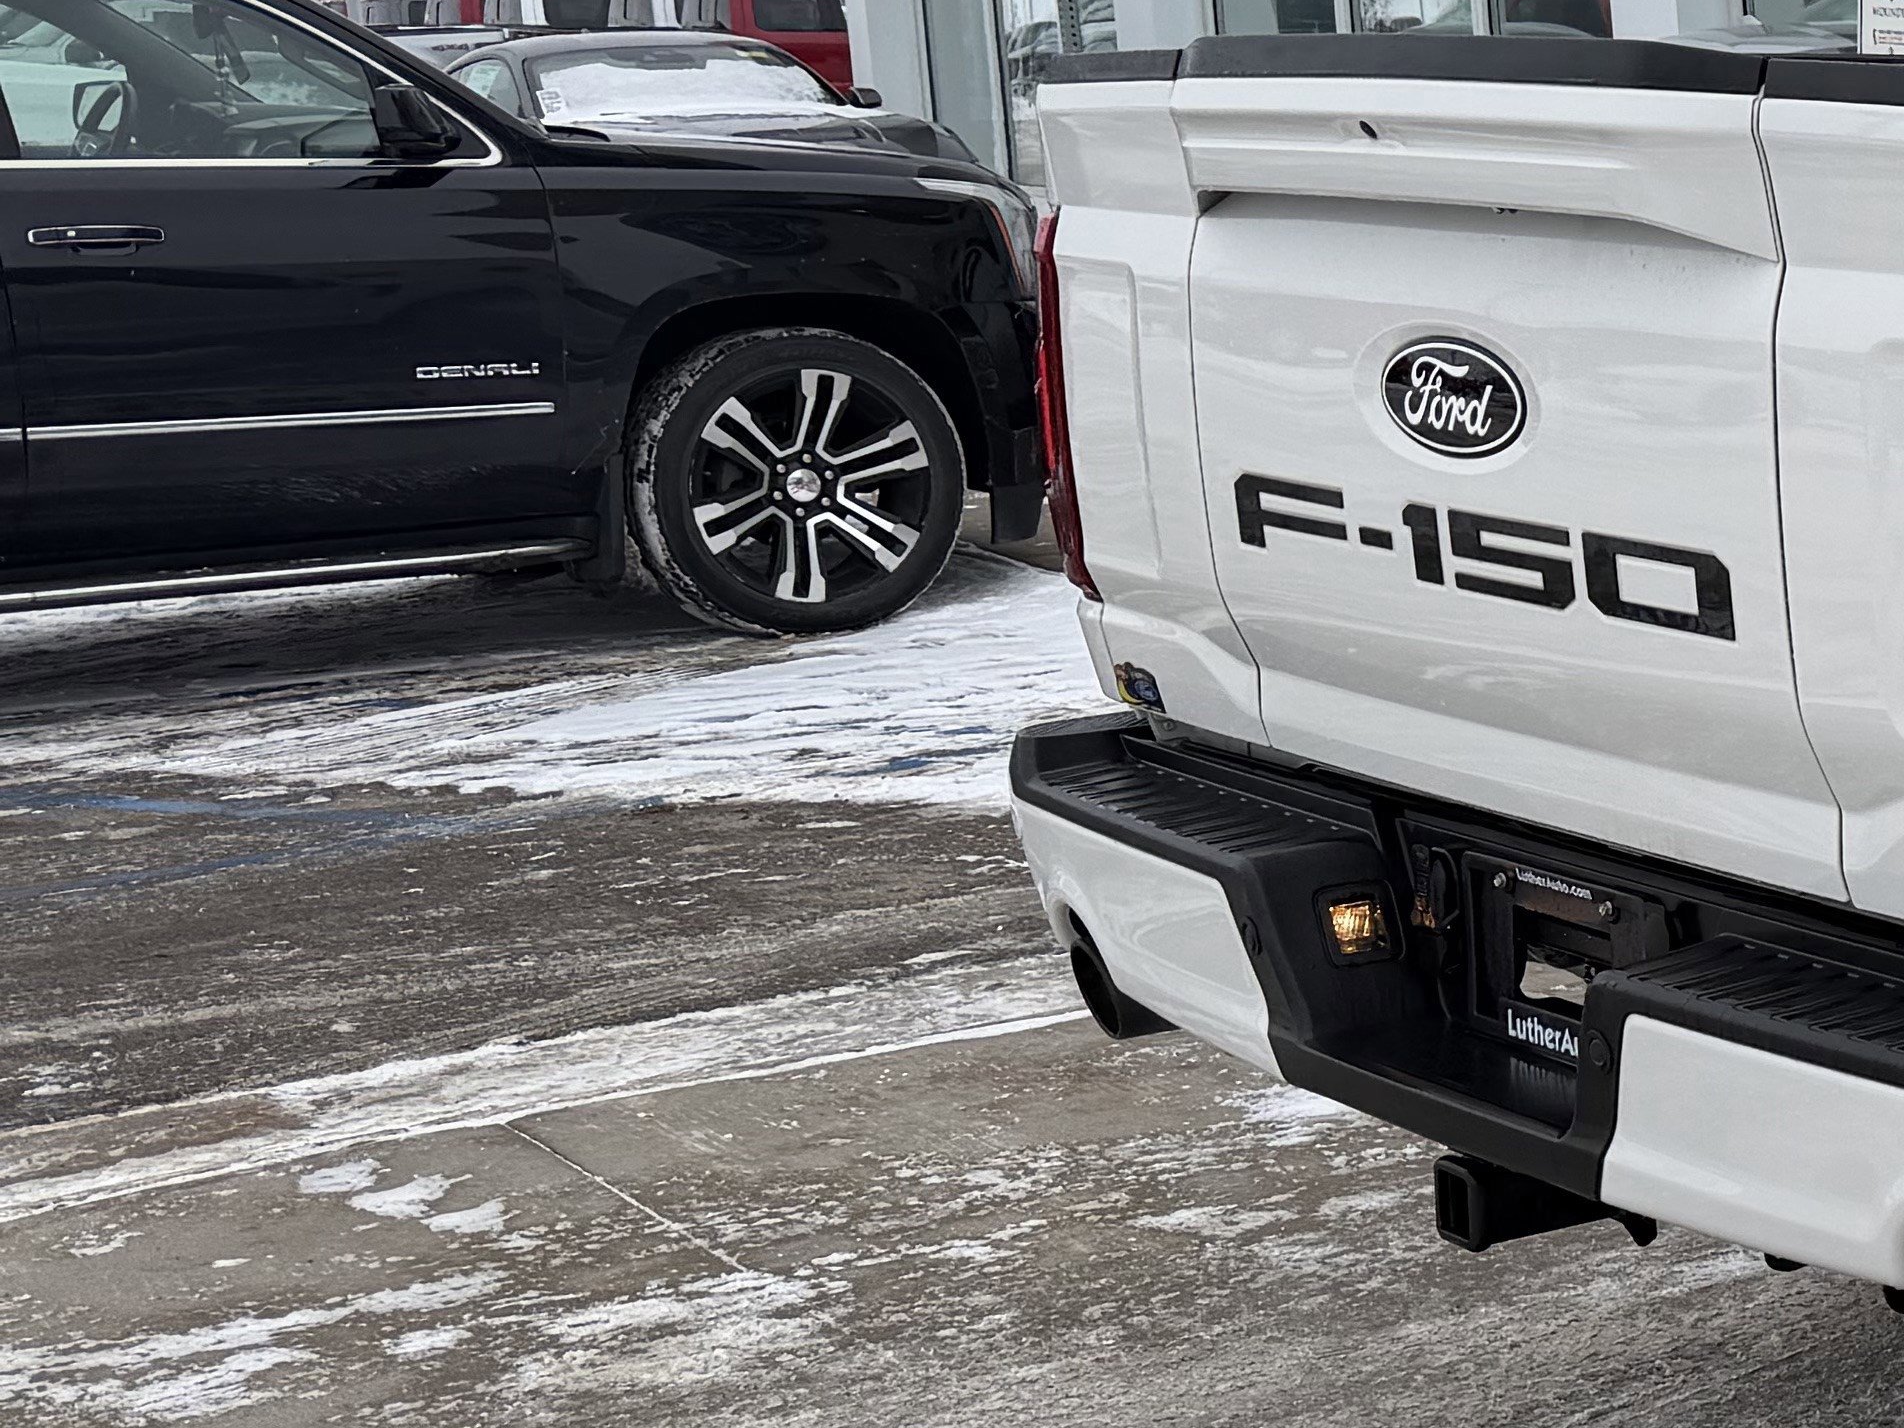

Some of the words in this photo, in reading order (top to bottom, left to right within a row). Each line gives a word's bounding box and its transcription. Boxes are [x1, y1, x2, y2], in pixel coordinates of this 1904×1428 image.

[415, 362, 540, 379] DENALI
[1404, 354, 1494, 437] Ford
[1234, 472, 1736, 642] F-150
